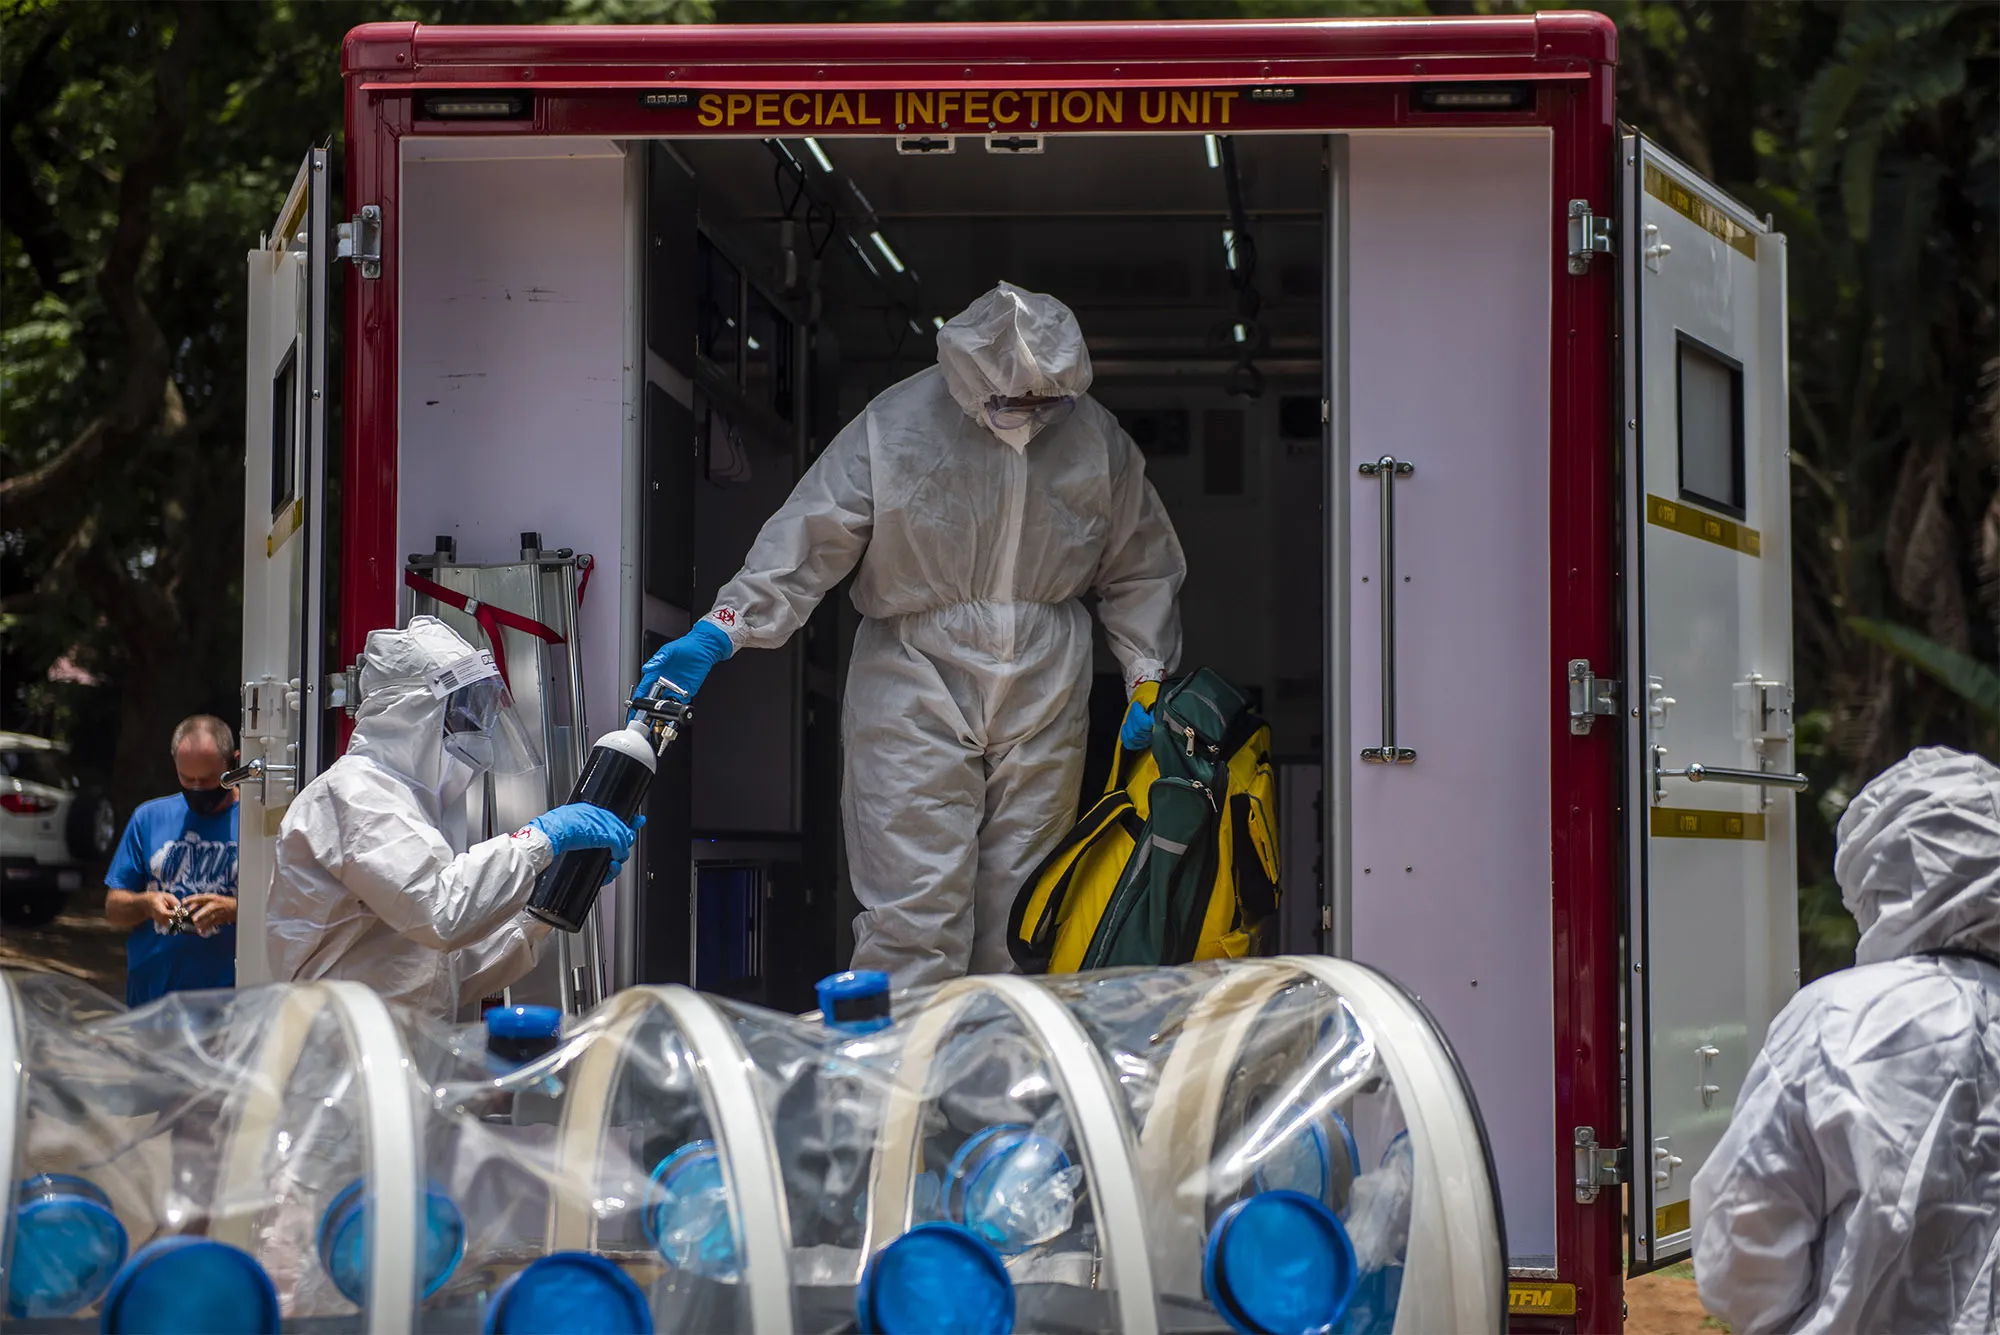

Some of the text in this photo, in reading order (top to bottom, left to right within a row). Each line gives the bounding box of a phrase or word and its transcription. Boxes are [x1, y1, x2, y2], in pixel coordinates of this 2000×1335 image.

[697, 90, 1239, 126] SPECIAL INFECTION UNIT
[1509, 1289, 1552, 1306] TFM
